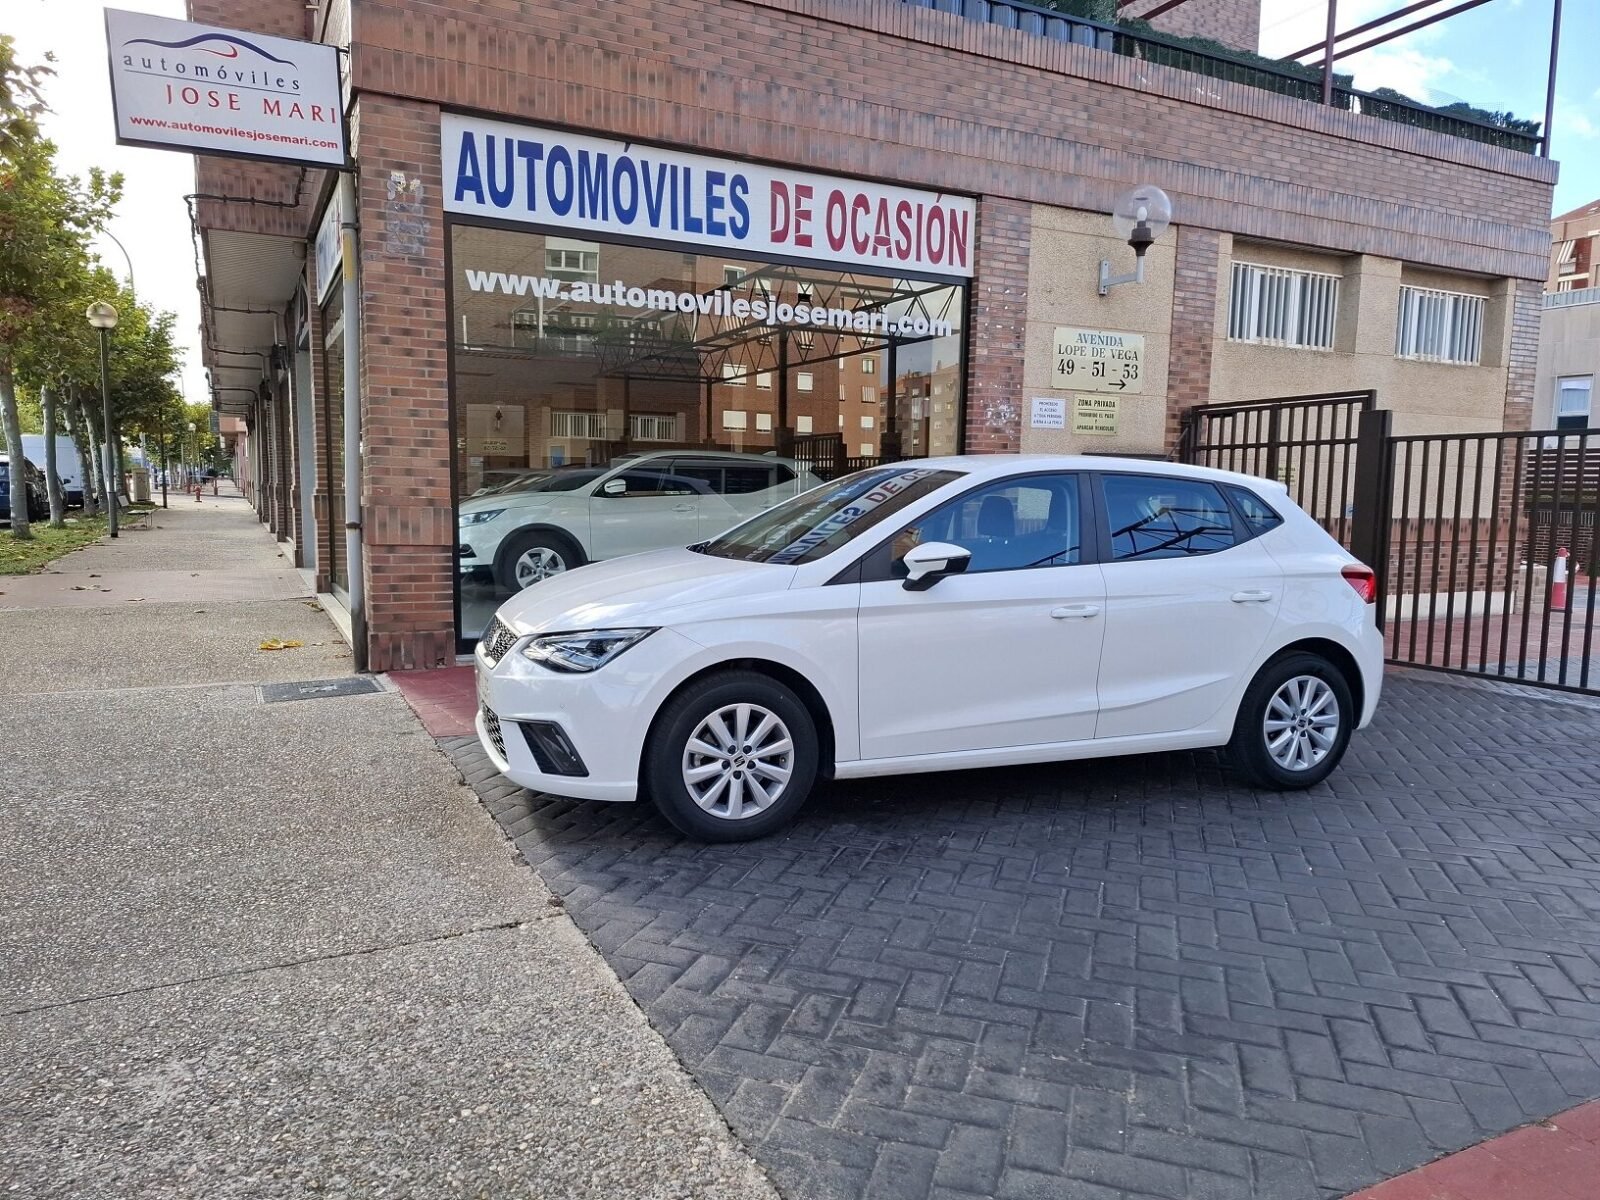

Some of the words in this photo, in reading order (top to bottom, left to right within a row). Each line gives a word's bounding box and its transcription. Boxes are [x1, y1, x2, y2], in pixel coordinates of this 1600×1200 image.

[123, 54, 300, 90] automóviles
[165, 83, 241, 111] JOSE
[263, 98, 337, 124] MARI
[129, 116, 338, 149] www.automovilesjosemari.com
[454, 131, 750, 240] AUTOMÓVILES
[770, 180, 813, 248] DE
[825, 189, 968, 268] OCASIÓN
[465, 269, 951, 336] www.automovilesjosemari.com
[1058, 344, 1087, 357] LOPE
[1091, 347, 1106, 358] DE
[1110, 349, 1138, 361] VEGA
[1076, 333, 1124, 347] AVENIDA
[1057, 359, 1075, 375] 49
[1091, 361, 1106, 377] 51
[1122, 364, 1138, 380] 53
[1094, 400, 1115, 408] PRIVADA
